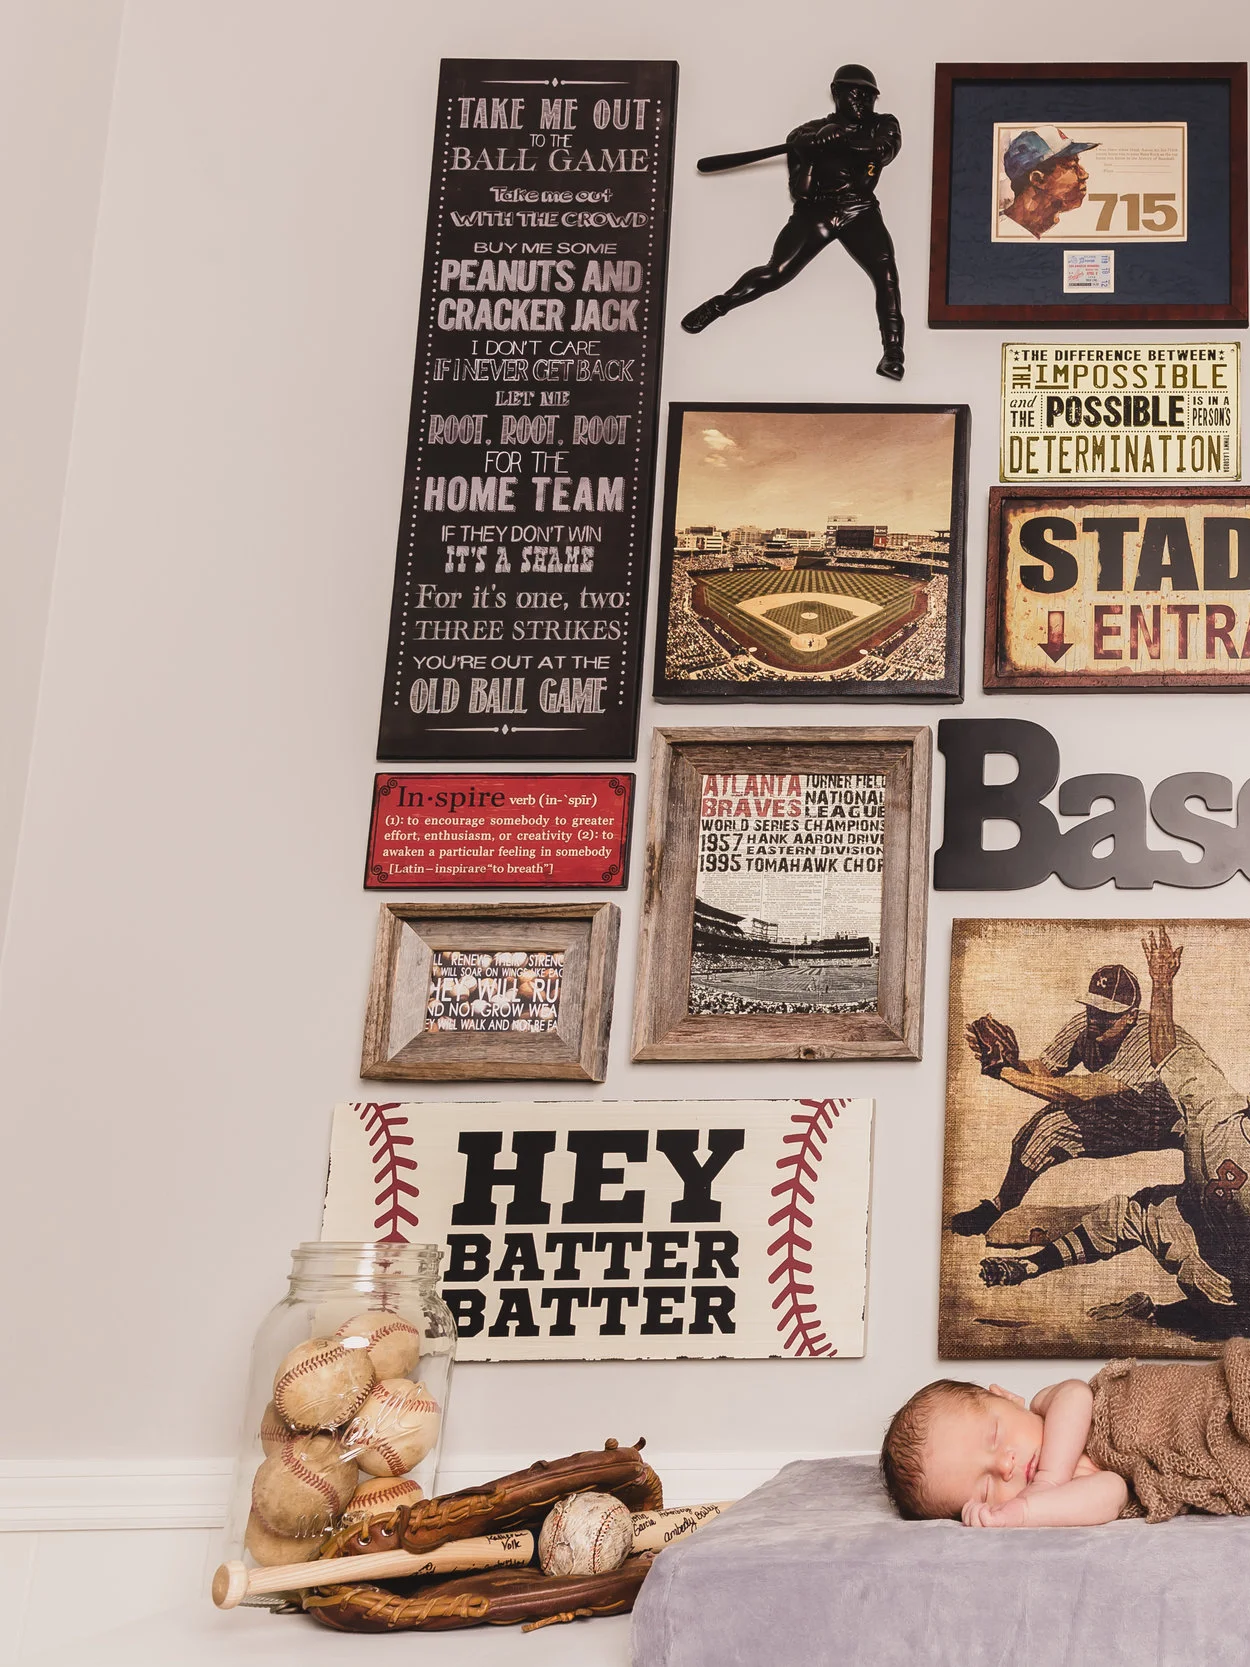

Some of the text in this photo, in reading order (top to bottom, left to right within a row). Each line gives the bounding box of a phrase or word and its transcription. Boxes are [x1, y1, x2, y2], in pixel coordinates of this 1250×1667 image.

[458, 97, 650, 130] TAKE ME OUT
[452, 147, 648, 171] BALL GAME
[1088, 193, 1178, 232] 715
[440, 260, 643, 292] PEANUTS AND
[437, 298, 639, 331] CRACKER JACK
[1022, 350, 1216, 361] THE DIFFERENCE BETWEEN
[1012, 364, 1228, 389] THE IMPOSSIBLE
[1010, 396, 1037, 408] and
[1193, 397, 1229, 405] IS IN A
[1011, 396, 1185, 427] THE POSSIBLE
[1193, 408, 1231, 426] PERSON'S
[1010, 435, 1221, 474] DETERMINATION
[423, 476, 625, 512] HOME TEAM
[414, 583, 624, 610] For it's one, two
[409, 678, 607, 713] OLD BALL GAME
[703, 775, 801, 796] ATLANTA
[509, 795, 536, 805] verb
[702, 799, 801, 817] BRAVES
[805, 806, 884, 818] LEAGUE
[407, 817, 419, 825] to
[425, 817, 485, 827] encourage
[490, 816, 550, 826] somebody
[555, 817, 567, 825] to
[572, 817, 615, 827] greater
[702, 820, 749, 831] WORLD
[754, 820, 799, 831] SERIES
[384, 831, 420, 841] effort,
[424, 831, 495, 841] enthusiasm,
[517, 831, 572, 841] creativity
[602, 831, 613, 839] to
[701, 834, 743, 852] 1957
[747, 834, 843, 844] HANK AARON
[382, 848, 424, 856] awaken
[439, 847, 494, 858] particular
[498, 847, 536, 858] feeling
[541, 847, 551, 856] in
[556, 847, 612, 858] somebody
[746, 846, 883, 855] EASTERN DIVISION
[700, 855, 741, 871] 1995
[746, 858, 838, 872] TOMAHAWK
[461, 967, 482, 977] SOAR
[486, 968, 498, 976] ON
[481, 1003, 523, 1017] GROW
[461, 1020, 509, 1030] WALK AND
[451, 1129, 745, 1225] HEY
[443, 1230, 739, 1282] BATTER
[445, 1286, 736, 1337] BATTER
